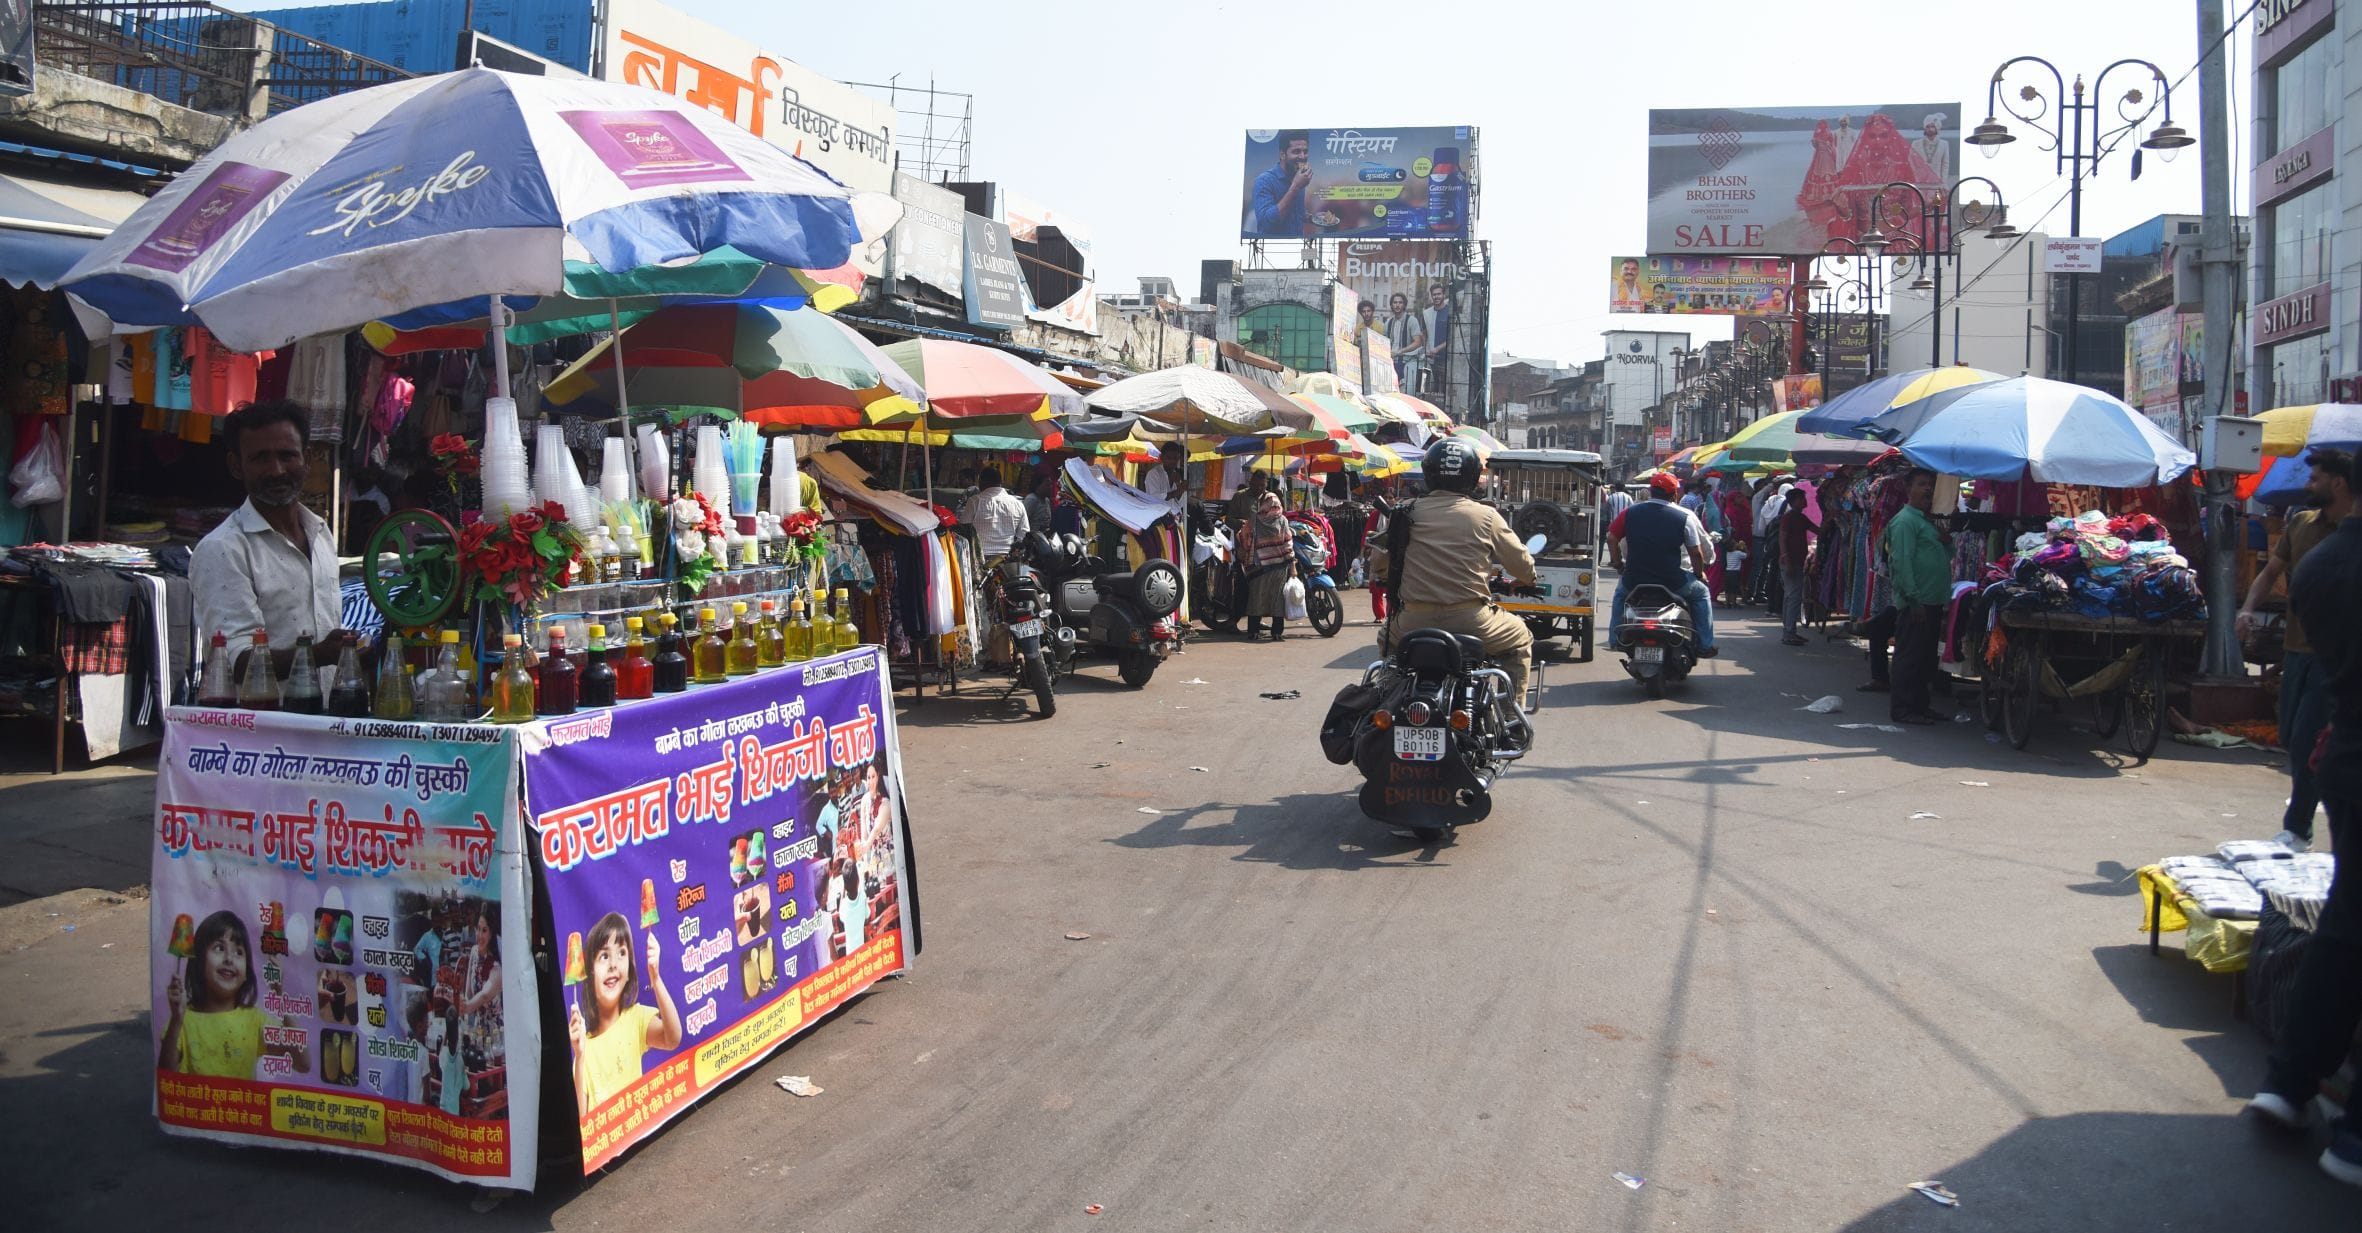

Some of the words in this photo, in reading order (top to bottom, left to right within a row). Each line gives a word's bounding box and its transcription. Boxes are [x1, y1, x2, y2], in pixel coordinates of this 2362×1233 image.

[783, 87, 840, 152] बिस्कुट
[843, 122, 890, 165] कम्पनी
[1325, 130, 1398, 158] गैस्ट्रियम
[1429, 184, 1462, 193] Gastrium
[1698, 176, 1748, 186] BHASIN
[1686, 190, 1756, 201] BROTHERS
[1675, 224, 1765, 248] SALE
[1355, 243, 1383, 251] RUPA
[1345, 257, 1468, 281] Bumchums
[2263, 294, 2314, 335] SINDH
[1617, 352, 1656, 365] NOORVIA
[354, 722, 427, 741] 9125884072,
[431, 726, 501, 743] 7307129492
[655, 728, 682, 754] बाम्बे
[682, 727, 699, 748] का
[700, 719, 726, 742] गोला
[728, 711, 764, 736] लखनऊ
[766, 701, 779, 725] की
[780, 695, 805, 727] चुस्की
[1403, 729, 1440, 740] UP50B
[1403, 742, 1440, 752] B0116
[189, 743, 230, 774] बाम्बे
[232, 751, 259, 776] का
[262, 747, 308, 779] गोला
[385, 754, 412, 789] की
[415, 758, 469, 800] चुस्की
[1390, 762, 1443, 782] ROYAL
[539, 780, 670, 867] करामत
[676, 741, 735, 822] भाई
[742, 718, 826, 802] शिकंजी
[831, 706, 876, 767] वाले
[1384, 786, 1453, 805] ENFIELD
[263, 799, 317, 872] भाई
[670, 860, 686, 883] रेड
[259, 903, 272, 924] रेड
[780, 899, 797, 921] यलो
[363, 950, 386, 966] काला
[263, 965, 281, 984] ग्रीन
[368, 1036, 387, 1057] सोडा
